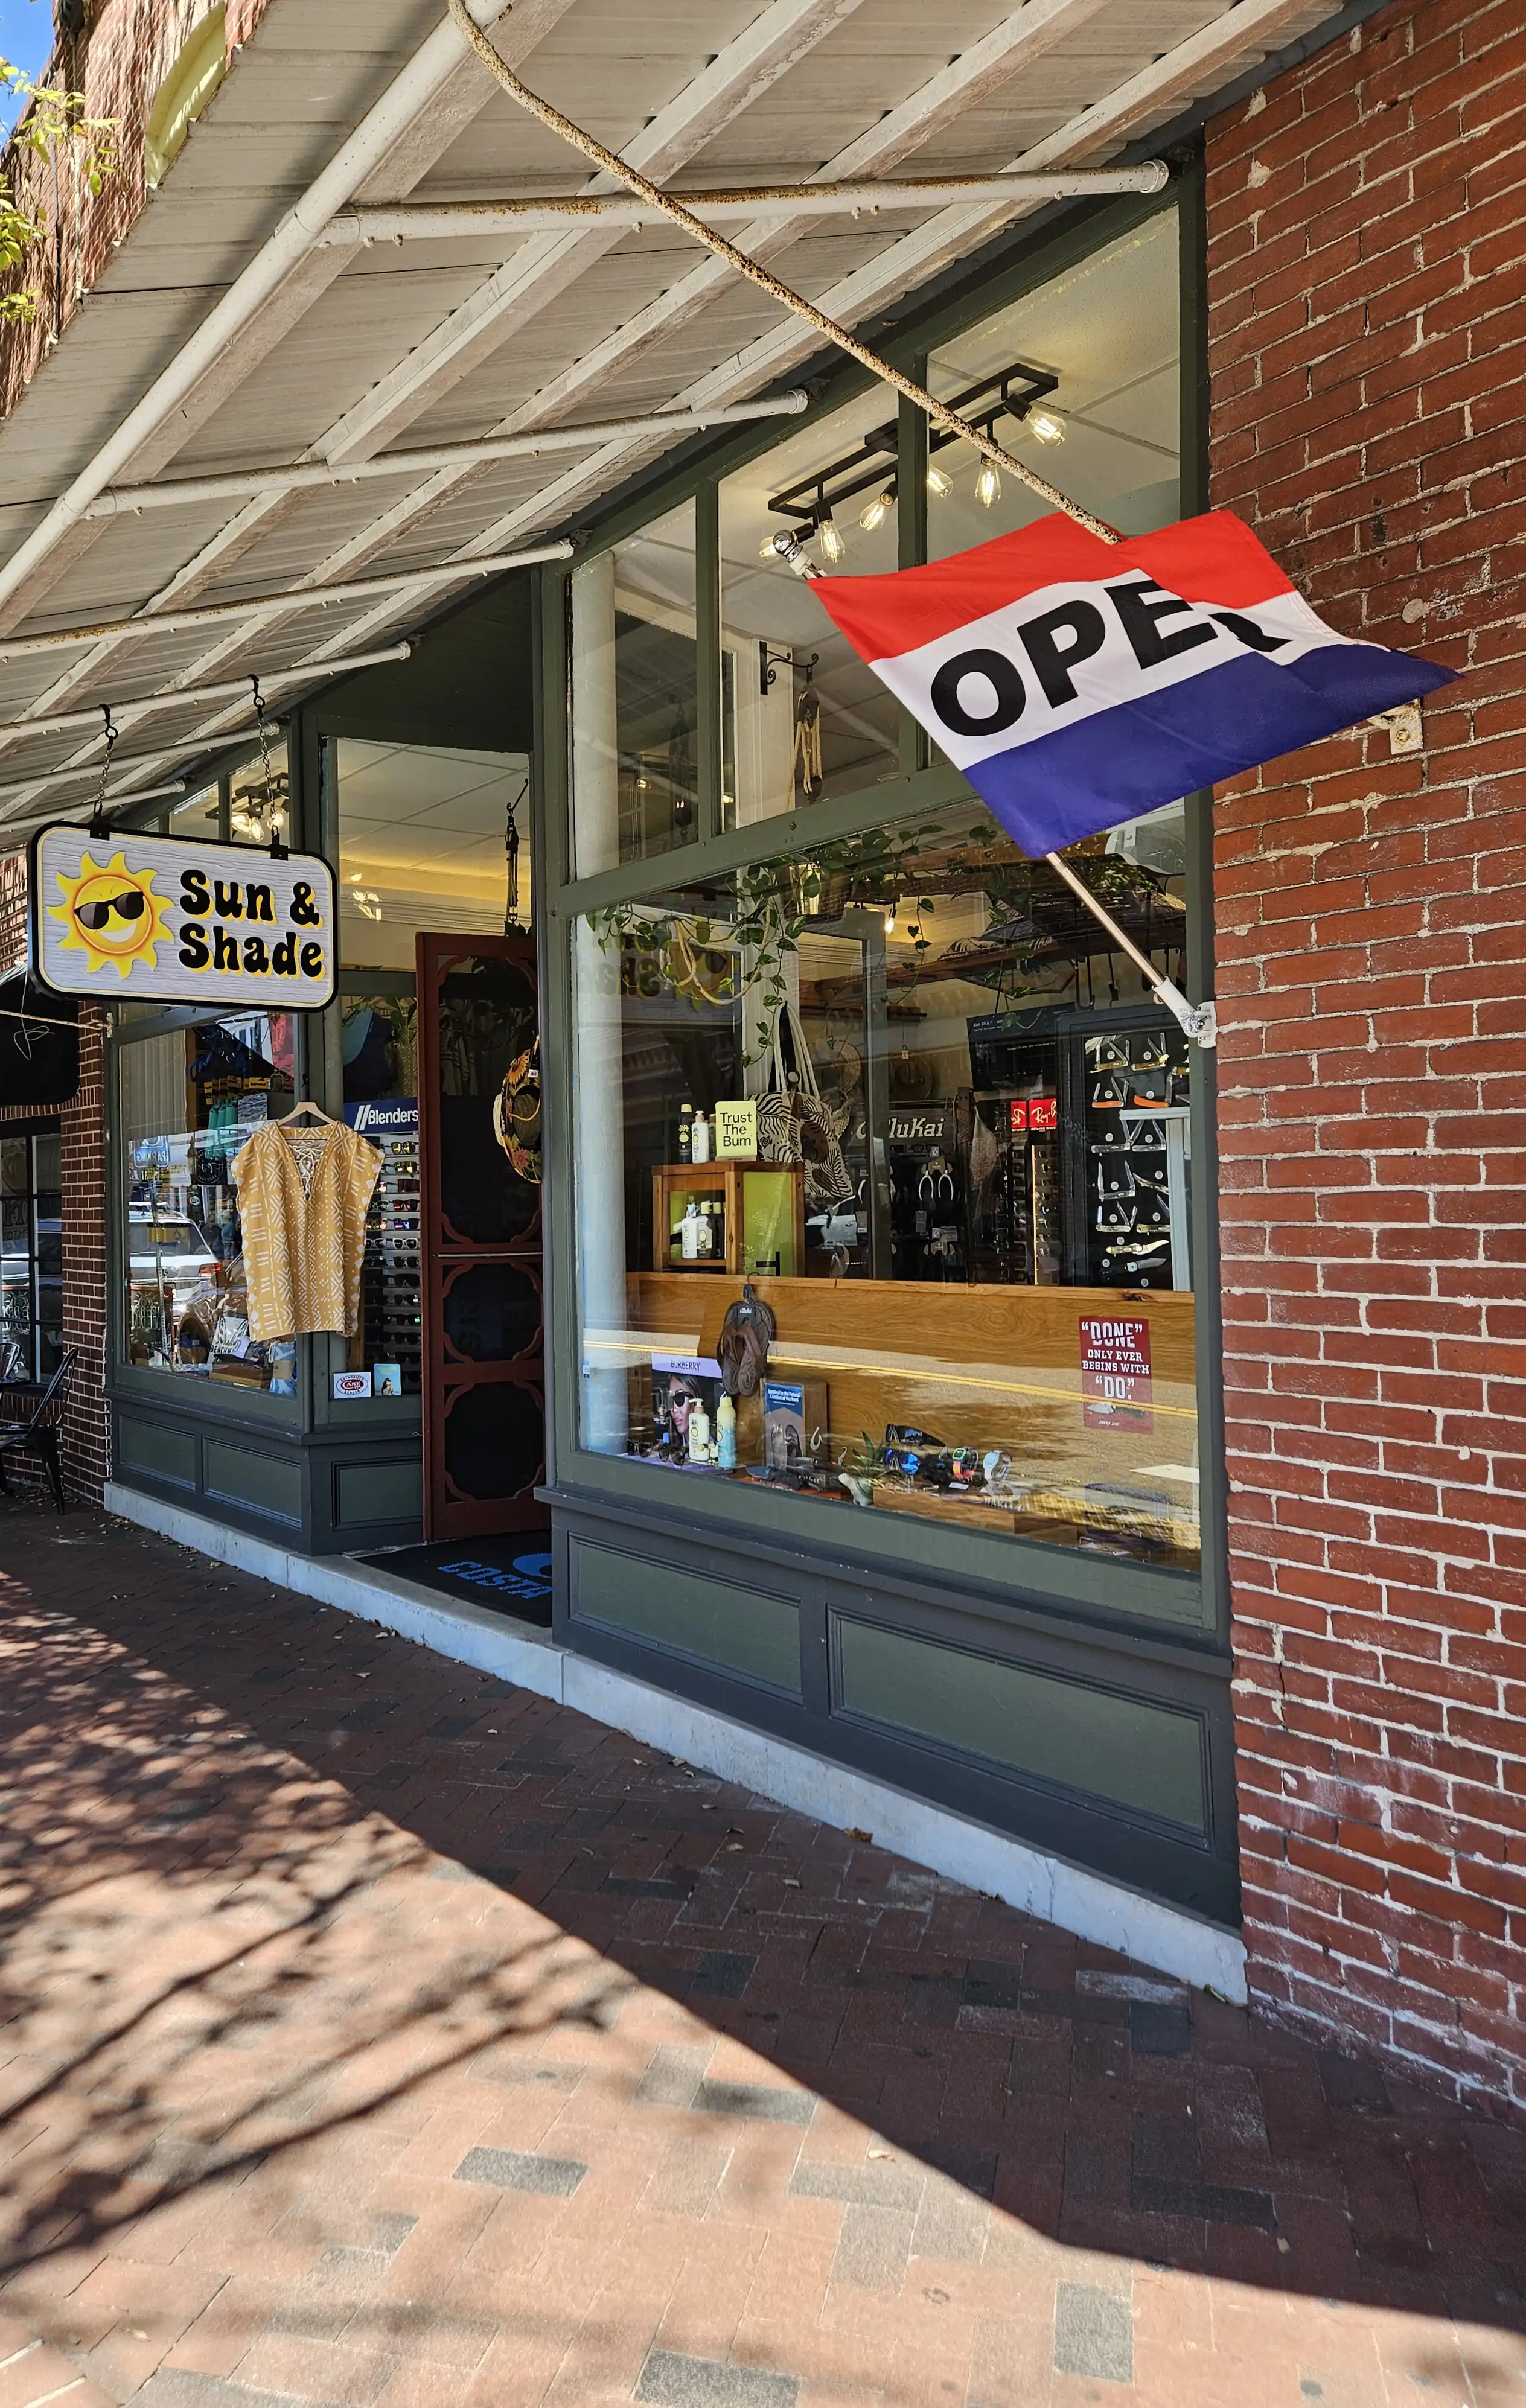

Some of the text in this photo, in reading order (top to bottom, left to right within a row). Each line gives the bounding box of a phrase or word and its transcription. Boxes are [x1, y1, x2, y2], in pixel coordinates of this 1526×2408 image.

[180, 869, 322, 928] Sun &
[179, 923, 325, 980] Shade
[368, 1107, 419, 1125] Blenders
[720, 1112, 753, 1123] Trust
[1031, 1101, 1057, 1124] Ray-B
[723, 1124, 747, 1135] The
[888, 1117, 945, 1138] luKai
[723, 1136, 752, 1147] Bum
[211, 1345, 234, 1354] BENCHM
[1088, 1349, 1143, 1362] ONLY EVER
[671, 1359, 700, 1371] BURBERRY
[1082, 1360, 1149, 1374] BEGINS WITH
[437, 1561, 554, 1599] COSTA
